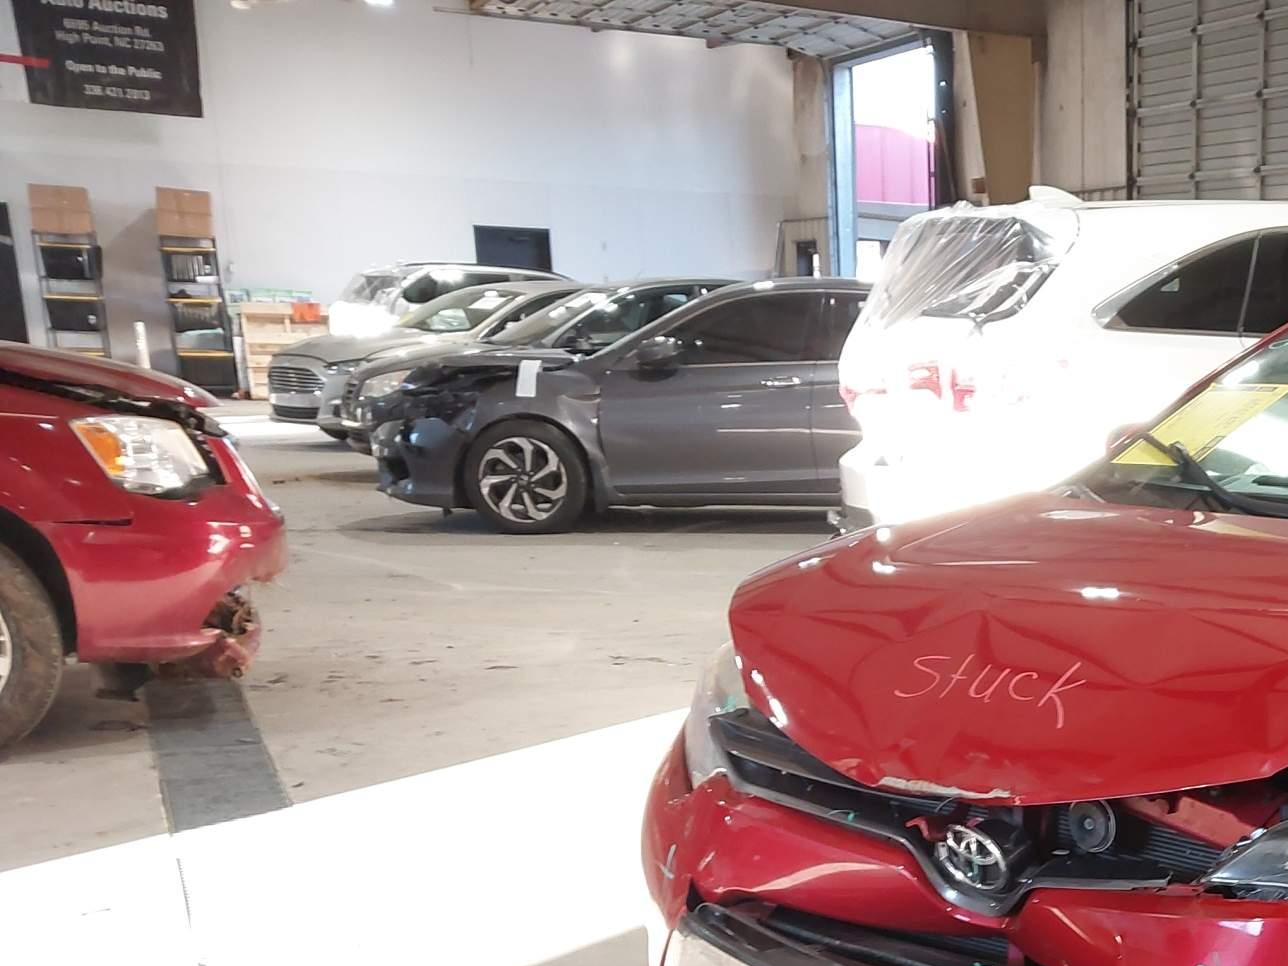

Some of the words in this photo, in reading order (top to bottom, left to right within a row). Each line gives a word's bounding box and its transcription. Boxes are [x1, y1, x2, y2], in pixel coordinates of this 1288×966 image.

[88, 0, 168, 18] Auctions
[92, 21, 133, 34] Auction
[55, 30, 80, 44] High
[65, 60, 95, 74] Open
[95, 64, 107, 74] to
[107, 65, 127, 75] the
